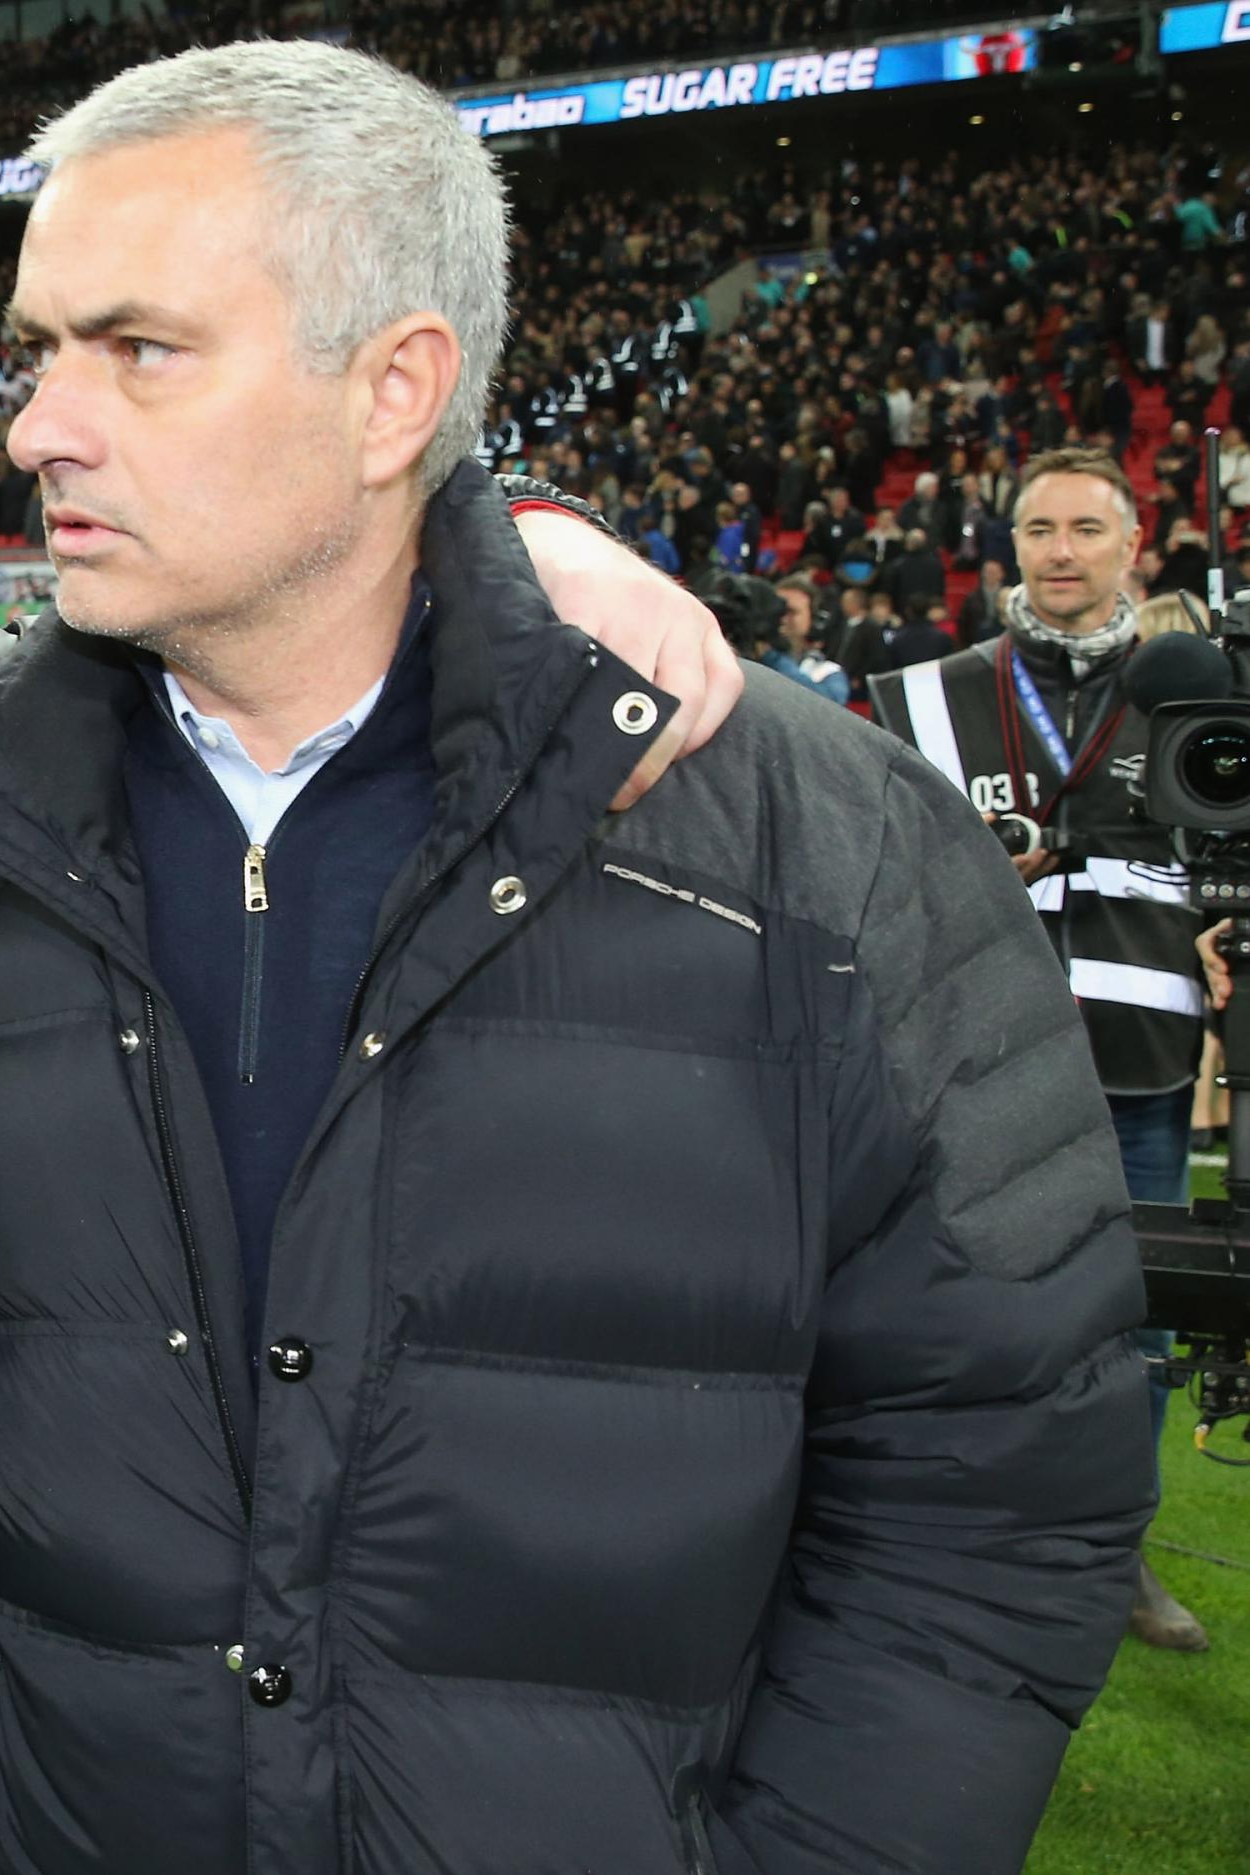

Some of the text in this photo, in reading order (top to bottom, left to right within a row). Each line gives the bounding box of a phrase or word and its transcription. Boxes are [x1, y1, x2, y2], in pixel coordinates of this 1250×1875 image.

[457, 47, 880, 136] arabao SUGAR FREE
[603, 863, 762, 935] PORSCHE DESIGN
